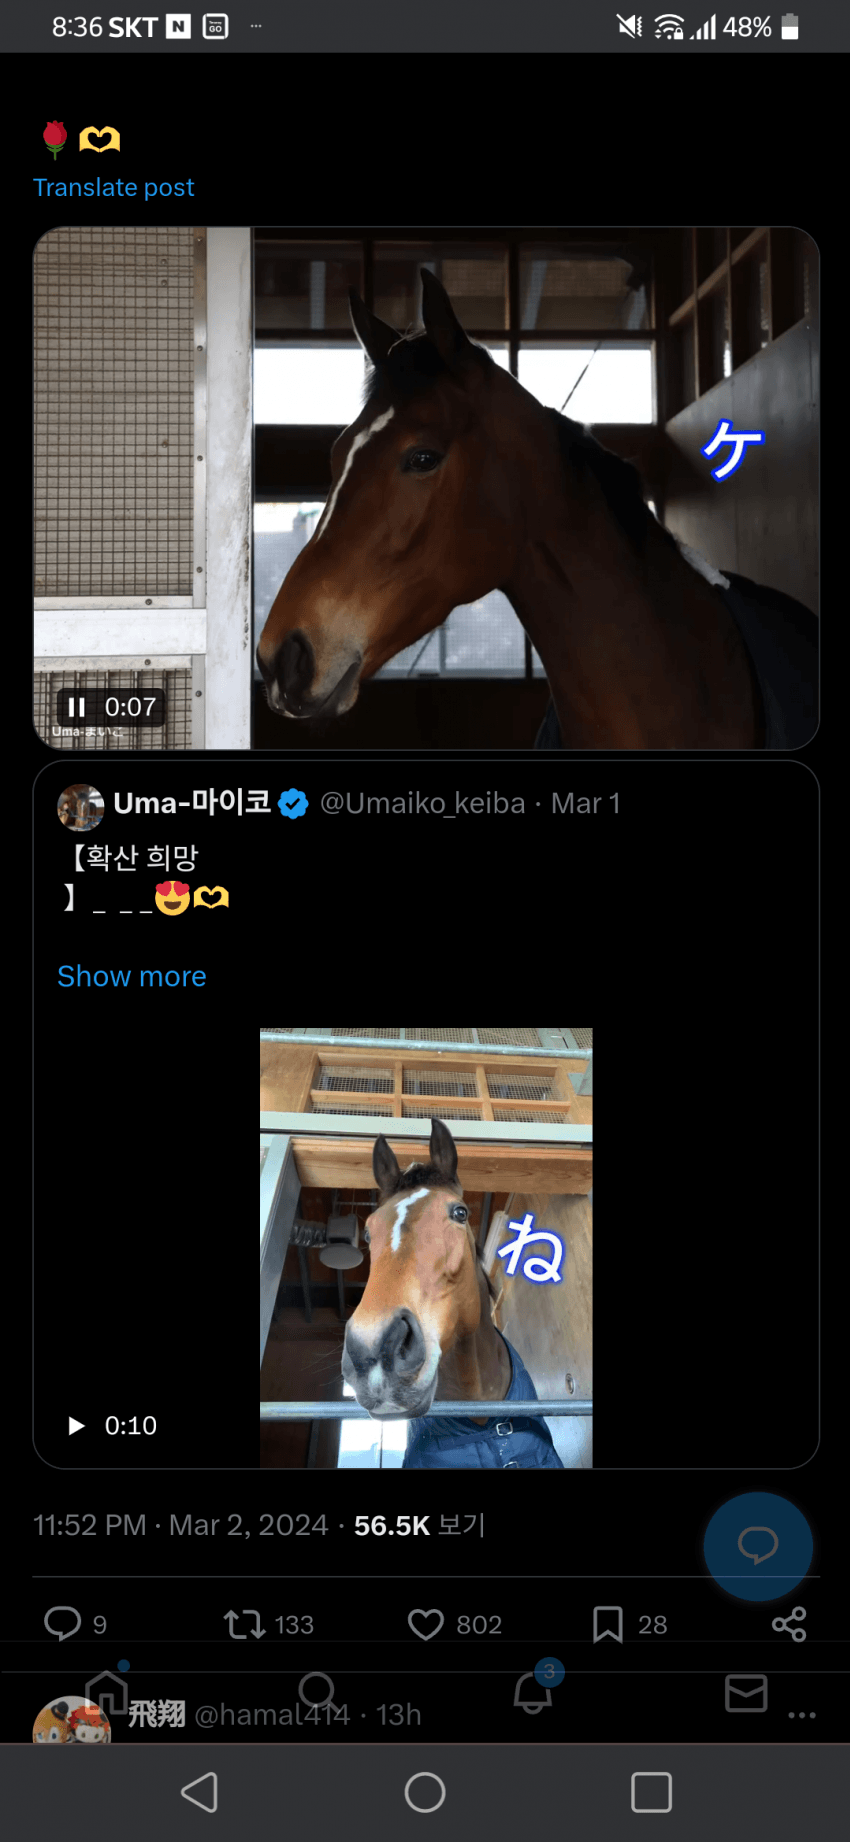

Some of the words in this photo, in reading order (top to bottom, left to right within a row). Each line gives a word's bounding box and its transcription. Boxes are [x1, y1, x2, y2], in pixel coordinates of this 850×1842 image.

[53, 16, 103, 37] 8:36
[109, 17, 159, 38] SKT
[209, 25, 222, 33] GO
[723, 16, 772, 37] 48%
[33, 177, 137, 197] Translate
[144, 179, 195, 201] post
[105, 697, 156, 717] 0:07
[115, 788, 271, 816] Uma-마이코
[321, 791, 525, 818] @Umaiko_keiba
[552, 793, 602, 814] Mar
[609, 793, 619, 814] 1
[147, 845, 199, 872] 희망
[58, 964, 131, 987] Show
[140, 970, 207, 987] more
[105, 1416, 156, 1435] 0:10
[33, 1514, 97, 1535] 11:52
[106, 1514, 146, 1535] PM
[170, 1514, 220, 1535] Mar
[227, 1514, 251, 1539] 2,
[259, 1514, 329, 1535] 2024
[354, 1515, 430, 1536] 56.5K
[438, 1513, 484, 1538] 보기
[93, 1616, 107, 1634] 9
[275, 1616, 314, 1634] 133
[456, 1616, 502, 1634] 802
[638, 1616, 668, 1634] 28
[544, 1664, 556, 1679] 3
[128, 1699, 186, 1728] 飛翔
[195, 1703, 351, 1728] @hamal414
[376, 1703, 421, 1725] 13h
